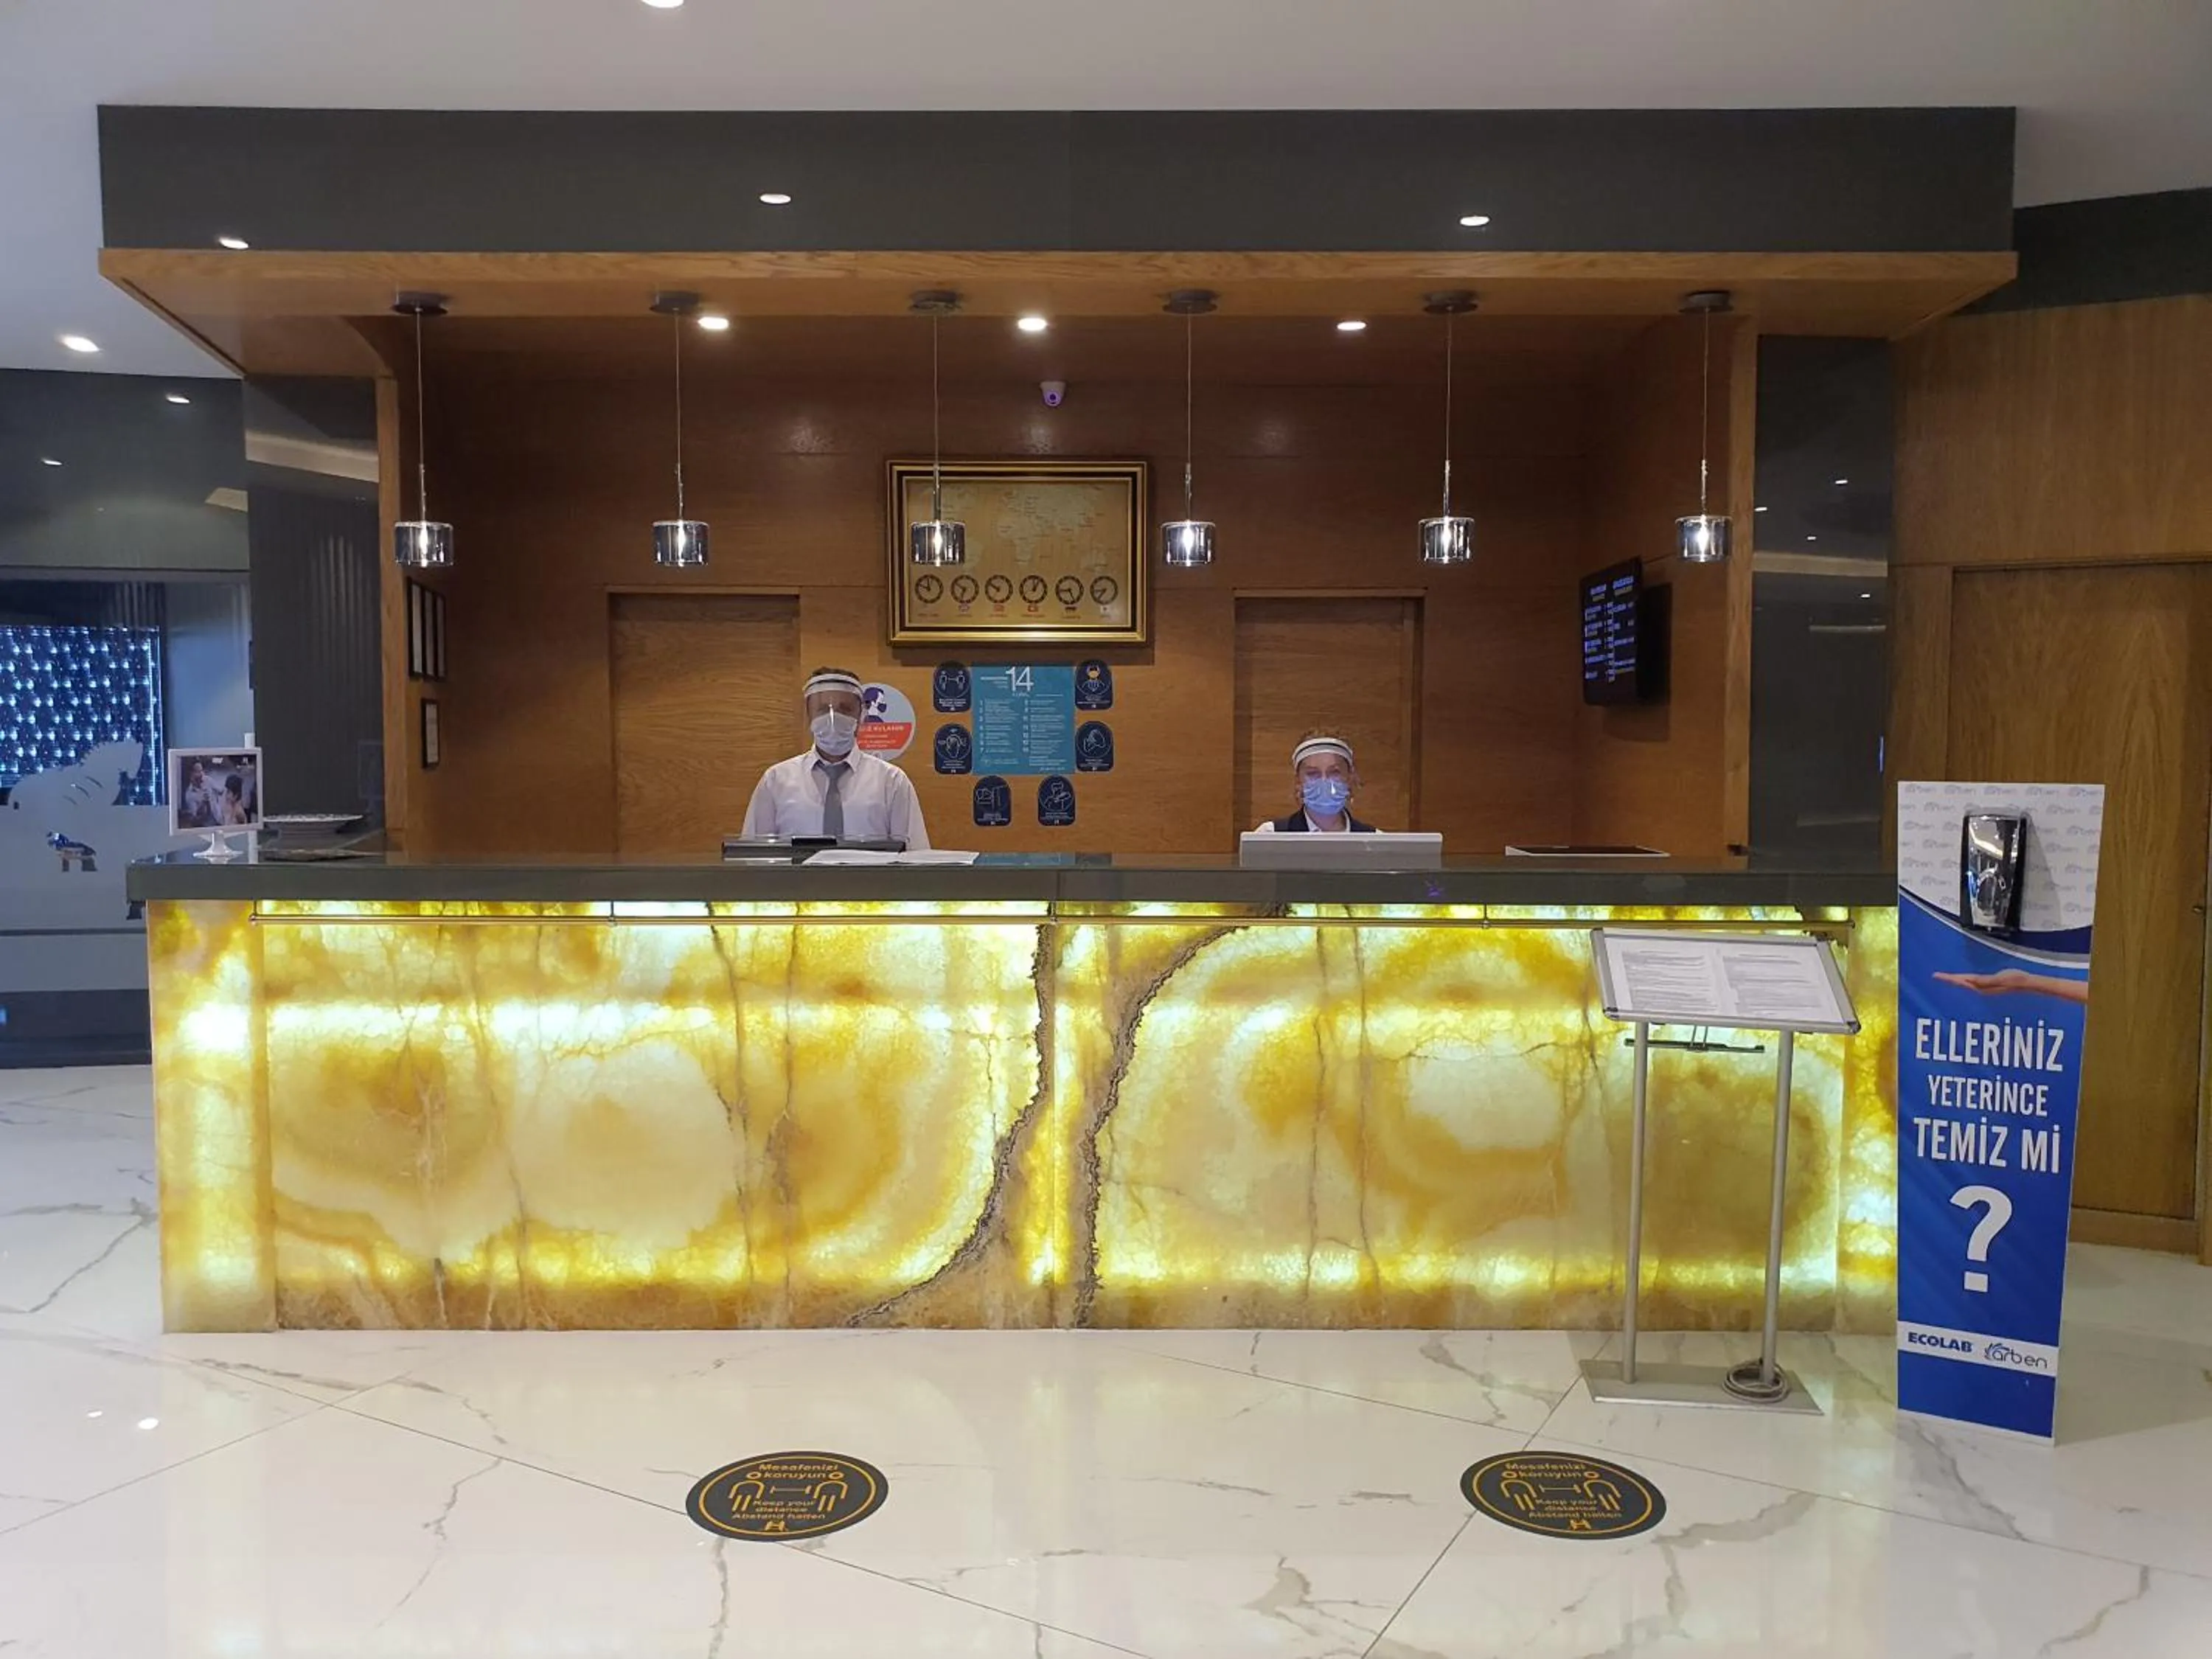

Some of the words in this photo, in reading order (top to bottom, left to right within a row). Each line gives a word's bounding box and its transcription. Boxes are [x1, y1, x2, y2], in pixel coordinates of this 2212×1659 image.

[1006, 667, 1034, 692] 14
[1916, 1017, 2064, 1072] ELLERİNİZ
[1927, 1074, 2049, 1117] YETERİNCE
[1913, 1116, 2008, 1168] TEMİZ
[2021, 1124, 2060, 1174] Mİ
[1950, 1185, 2013, 1293] ?
[1907, 1332, 1972, 1353] ECOLAB
